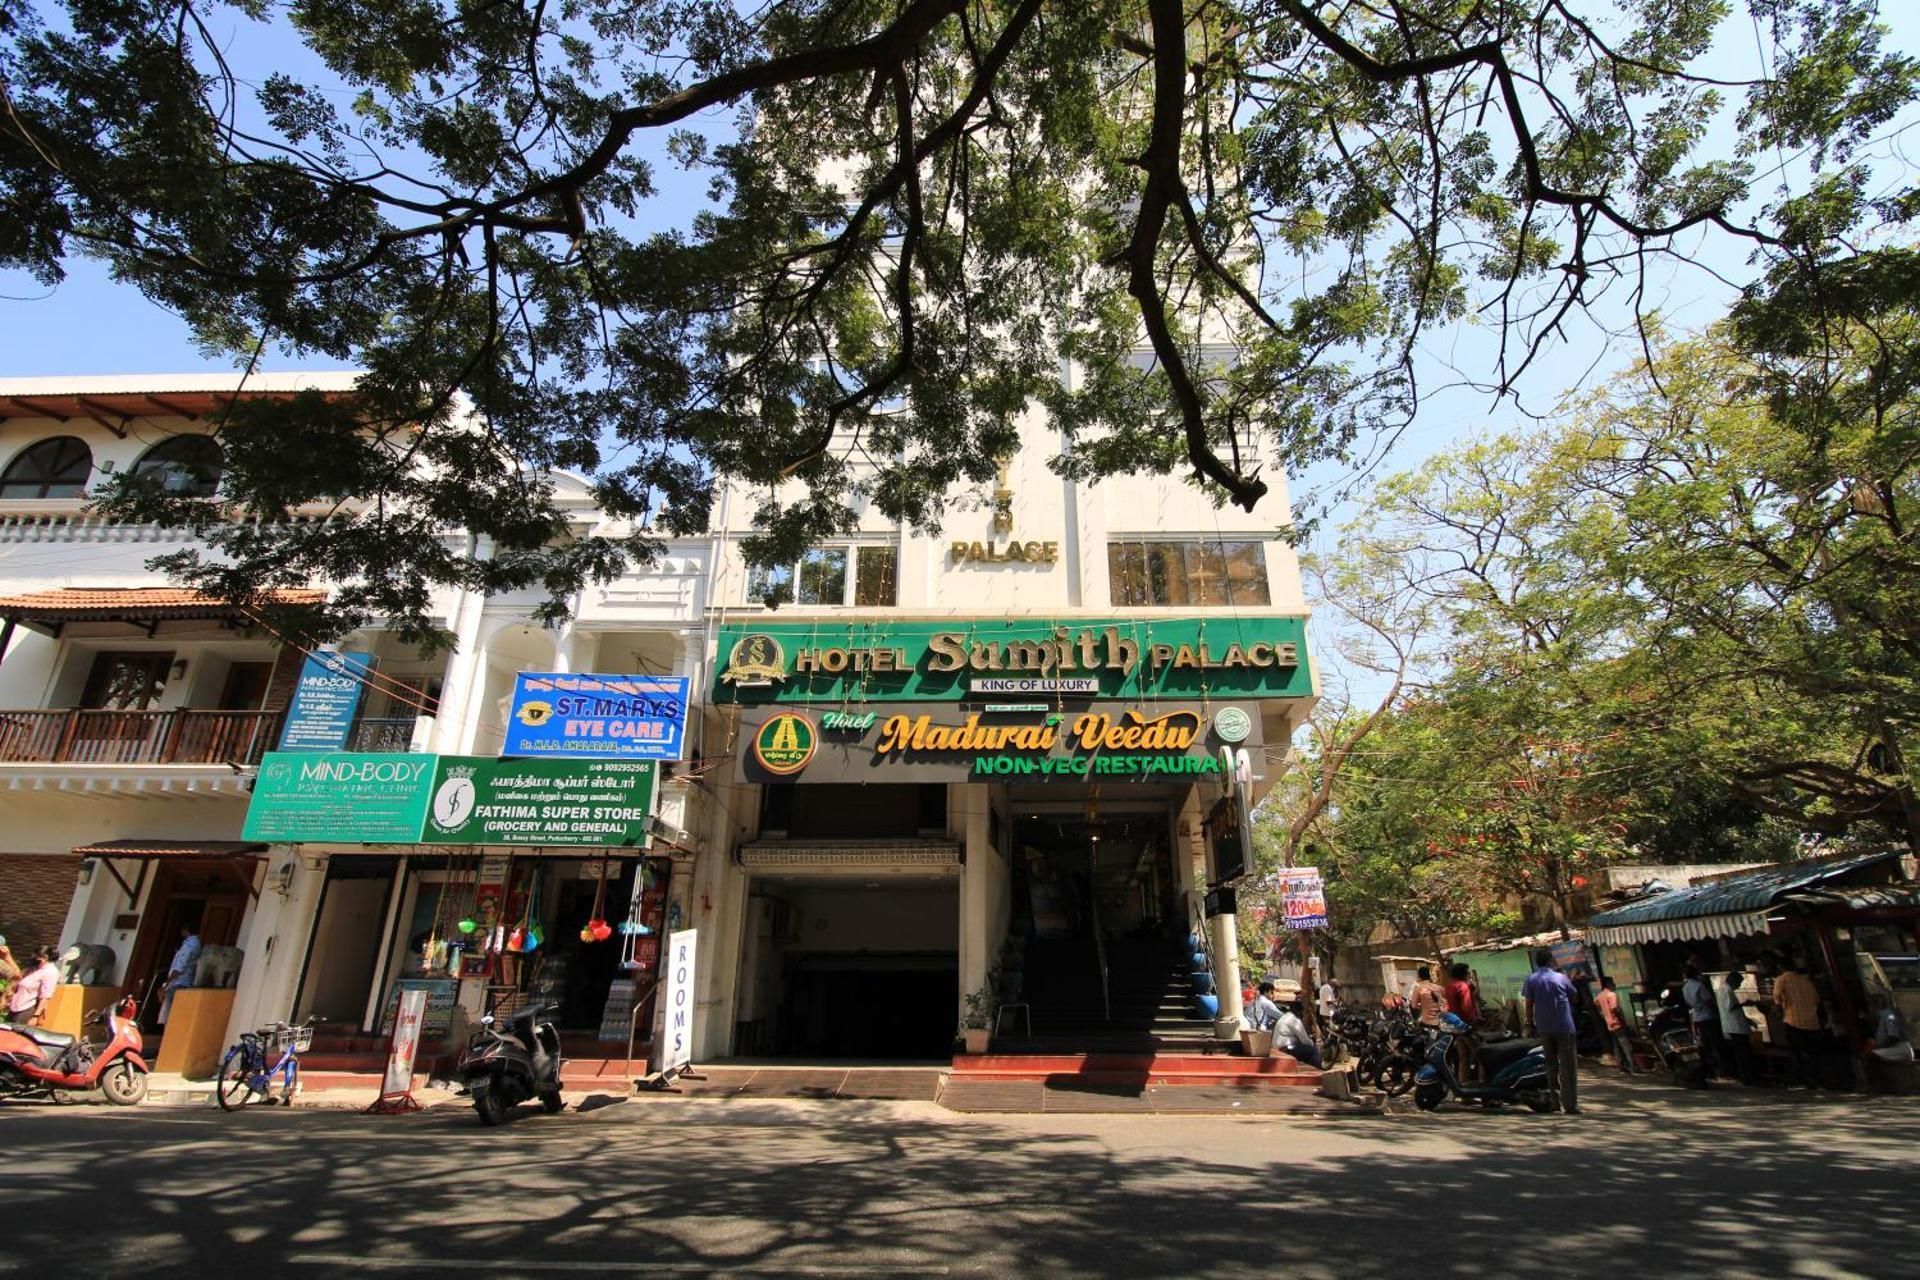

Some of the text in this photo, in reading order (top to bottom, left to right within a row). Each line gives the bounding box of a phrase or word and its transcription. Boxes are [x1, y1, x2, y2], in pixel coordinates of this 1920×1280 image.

[951, 541, 1059, 563] PALACE
[796, 627, 1300, 677] HOTEL Sumith PALACE
[303, 677, 357, 687] MIND-BODY
[981, 679, 1092, 691] KING OF LUXURY
[564, 720, 664, 739] EYE CARE
[821, 711, 878, 731] Hotel
[878, 713, 1058, 754] Madurai
[1073, 710, 1204, 751] Veedu
[300, 762, 427, 782] MIND-BODY
[976, 755, 1222, 775] NON-VEG RESTAURA
[490, 773, 550, 788] ஃபாத்திமா
[553, 775, 589, 789] சூப்பர்
[475, 805, 642, 820] FATHIMA SUPER STORE
[484, 821, 627, 834] (GROCERY AND GENERAL)
[1284, 899, 1304, 917] 120
[674, 945, 687, 1051] ROOMS
